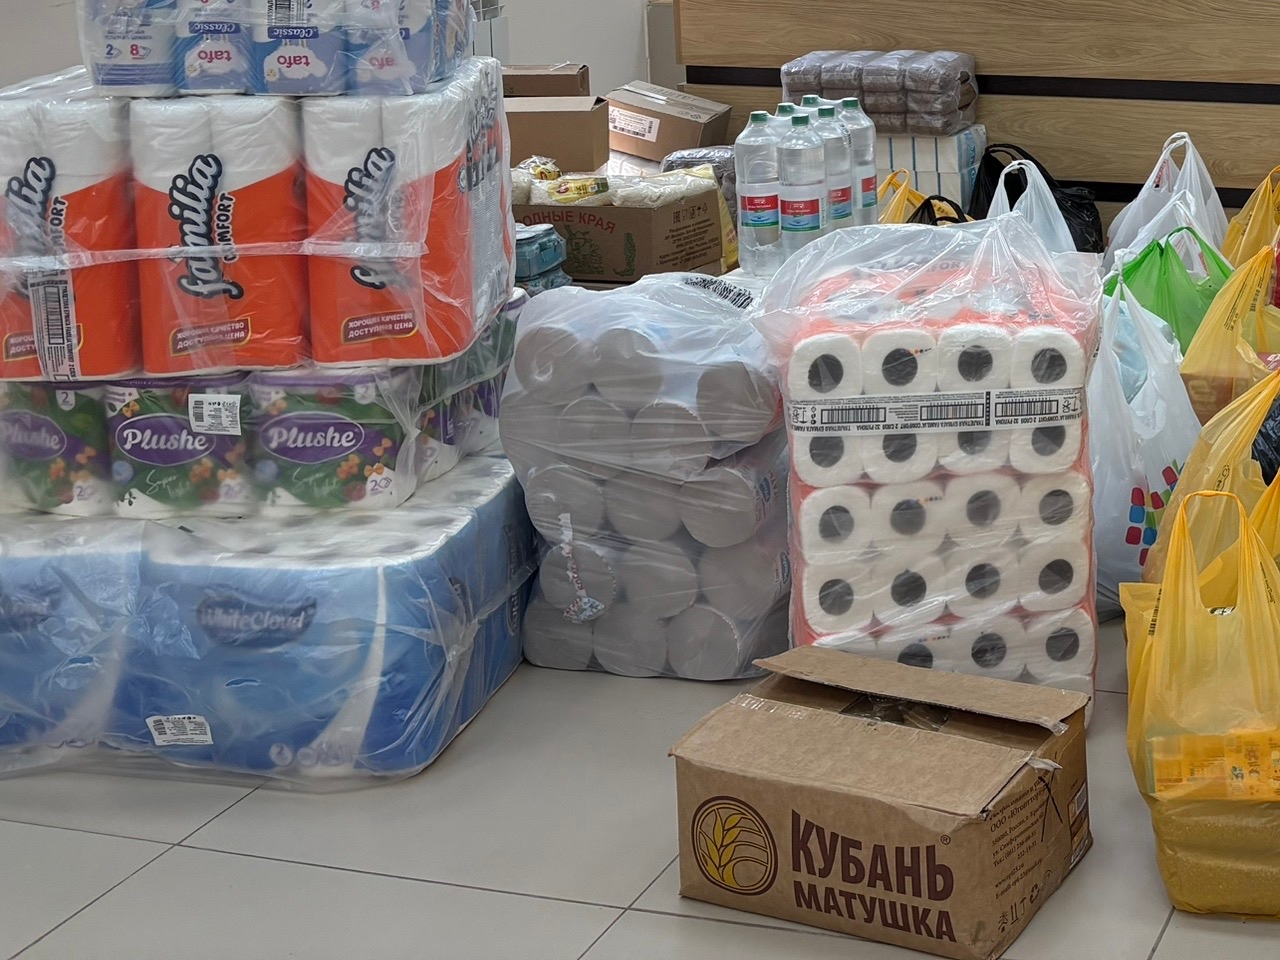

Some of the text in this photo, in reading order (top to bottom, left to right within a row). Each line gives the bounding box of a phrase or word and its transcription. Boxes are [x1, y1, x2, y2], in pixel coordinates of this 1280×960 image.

[194, 22, 236, 33] Classic
[272, 27, 314, 38] Classic
[197, 49, 233, 69] tafo
[276, 53, 311, 71] tafo
[168, 154, 244, 299] familia
[215, 192, 236, 263] COMFORT
[578, 213, 616, 235] КРАЯ
[394, 321, 414, 331] ЦЕНА
[122, 427, 209, 452] Plushe
[267, 426, 357, 448] Plushe
[991, 816, 1006, 833] ООО
[791, 809, 955, 902] КУБАНЬ
[792, 879, 958, 944] МАТУШКА
